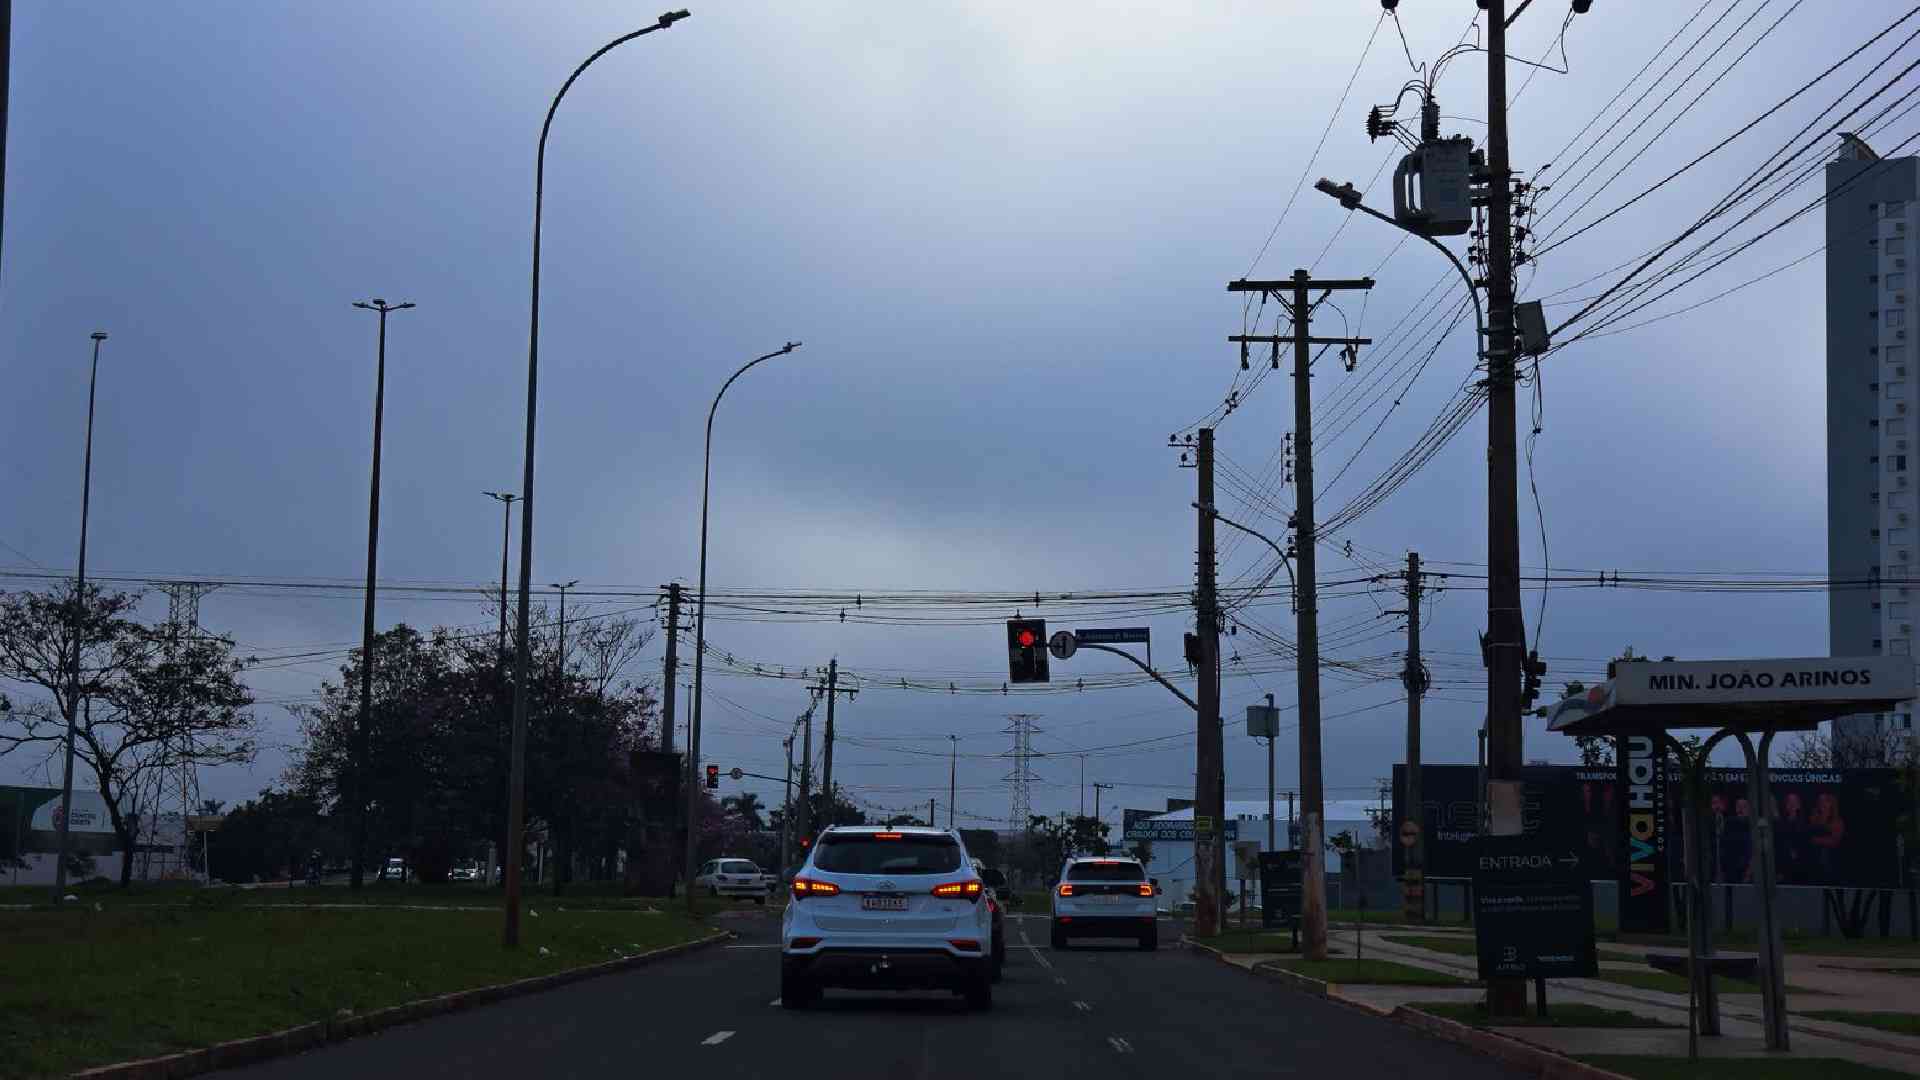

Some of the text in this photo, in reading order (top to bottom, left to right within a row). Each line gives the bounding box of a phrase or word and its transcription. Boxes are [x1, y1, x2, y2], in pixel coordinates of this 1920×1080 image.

[1648, 669, 1872, 690] MIN. JOÃO ARINOS
[1479, 855, 1554, 871] ENTRADA
